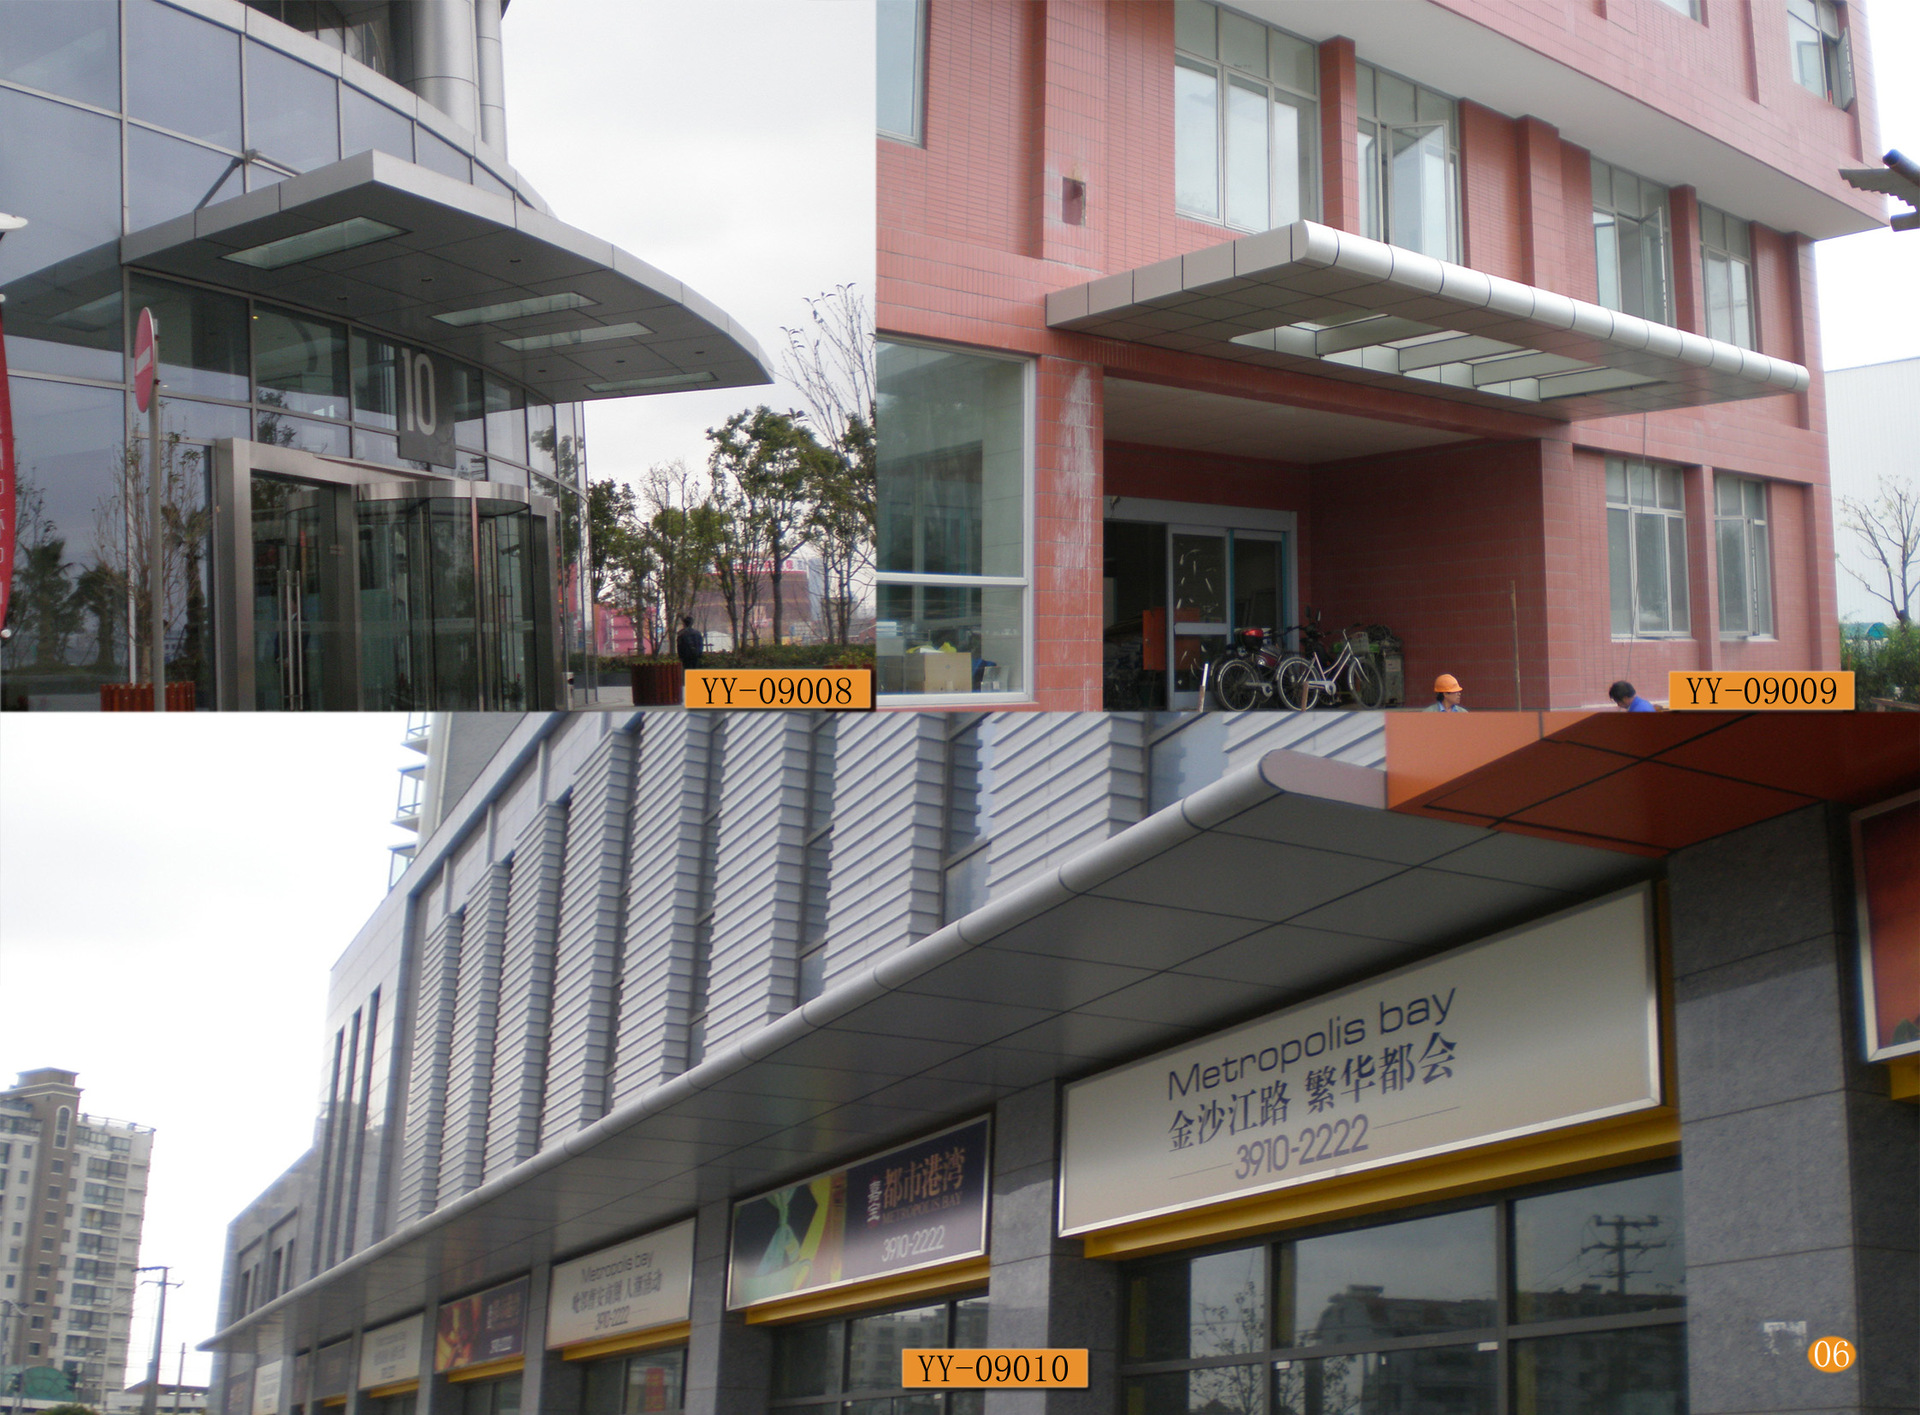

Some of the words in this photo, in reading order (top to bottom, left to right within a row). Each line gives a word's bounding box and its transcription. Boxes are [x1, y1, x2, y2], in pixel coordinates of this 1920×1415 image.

[402, 347, 436, 436] 10
[1168, 1015, 1366, 1101] Metropolis
[1379, 987, 1457, 1034] bay
[1168, 1080, 1292, 1152] 金沙江路
[1304, 1031, 1458, 1113] 繁华都会
[884, 1146, 966, 1210] 都市港湾
[1234, 1113, 1370, 1180] 3910-2222
[882, 1225, 945, 1262] 3910-2222
